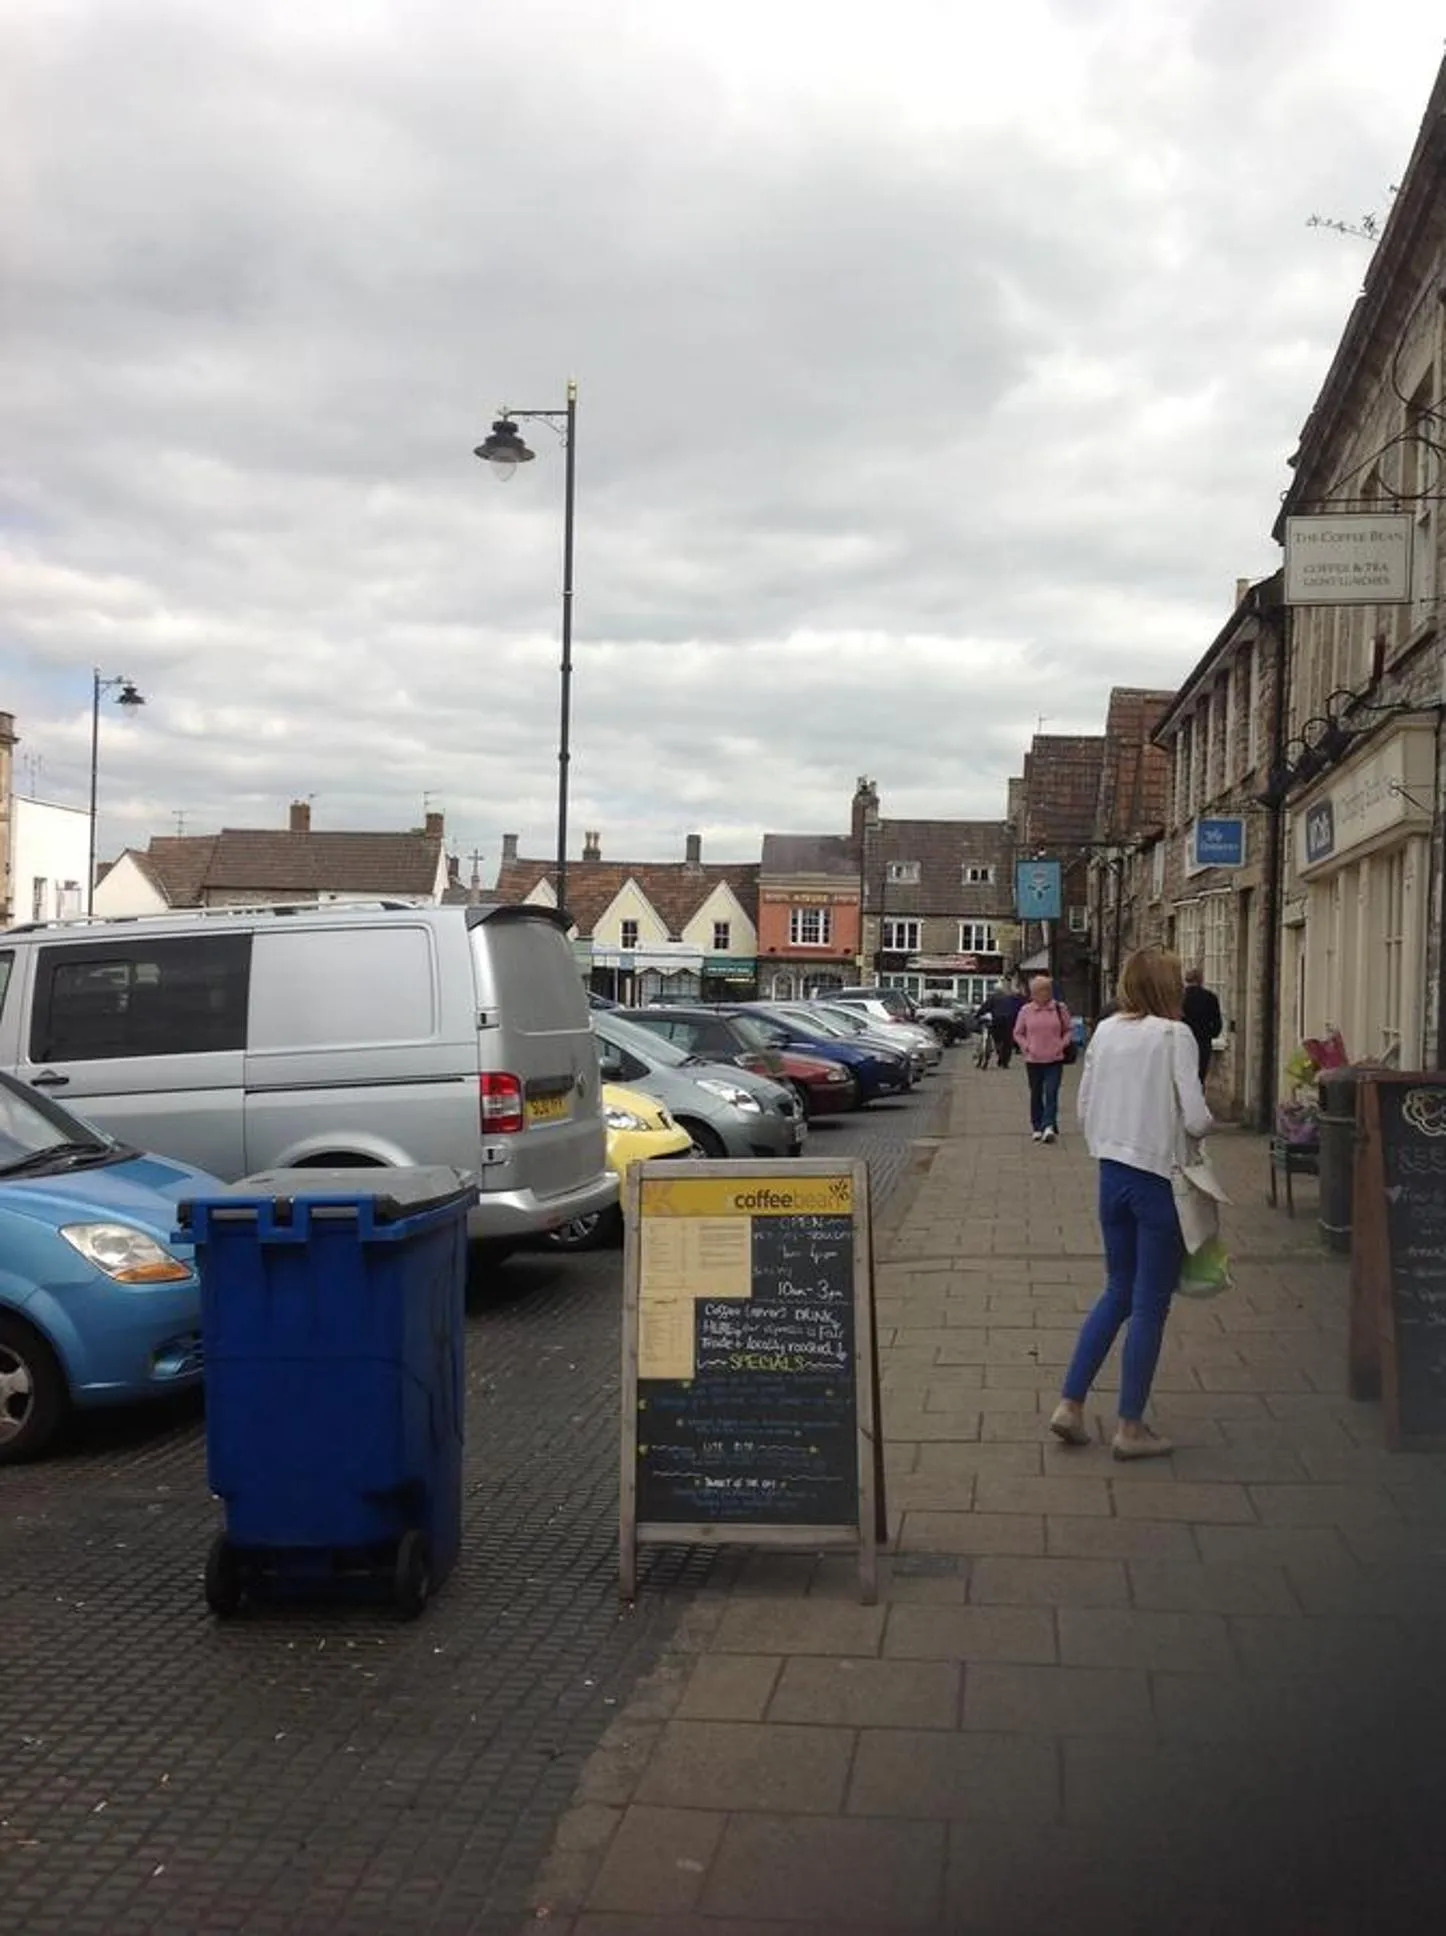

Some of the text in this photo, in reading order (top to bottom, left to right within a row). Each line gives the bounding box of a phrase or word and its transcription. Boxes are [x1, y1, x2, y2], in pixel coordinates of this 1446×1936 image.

[1295, 530, 1404, 543] THE COFFEE BEAN
[1303, 562, 1349, 573] COFFEE
[1364, 562, 1389, 573] TEA
[729, 1352, 806, 1371] SPECIALS
